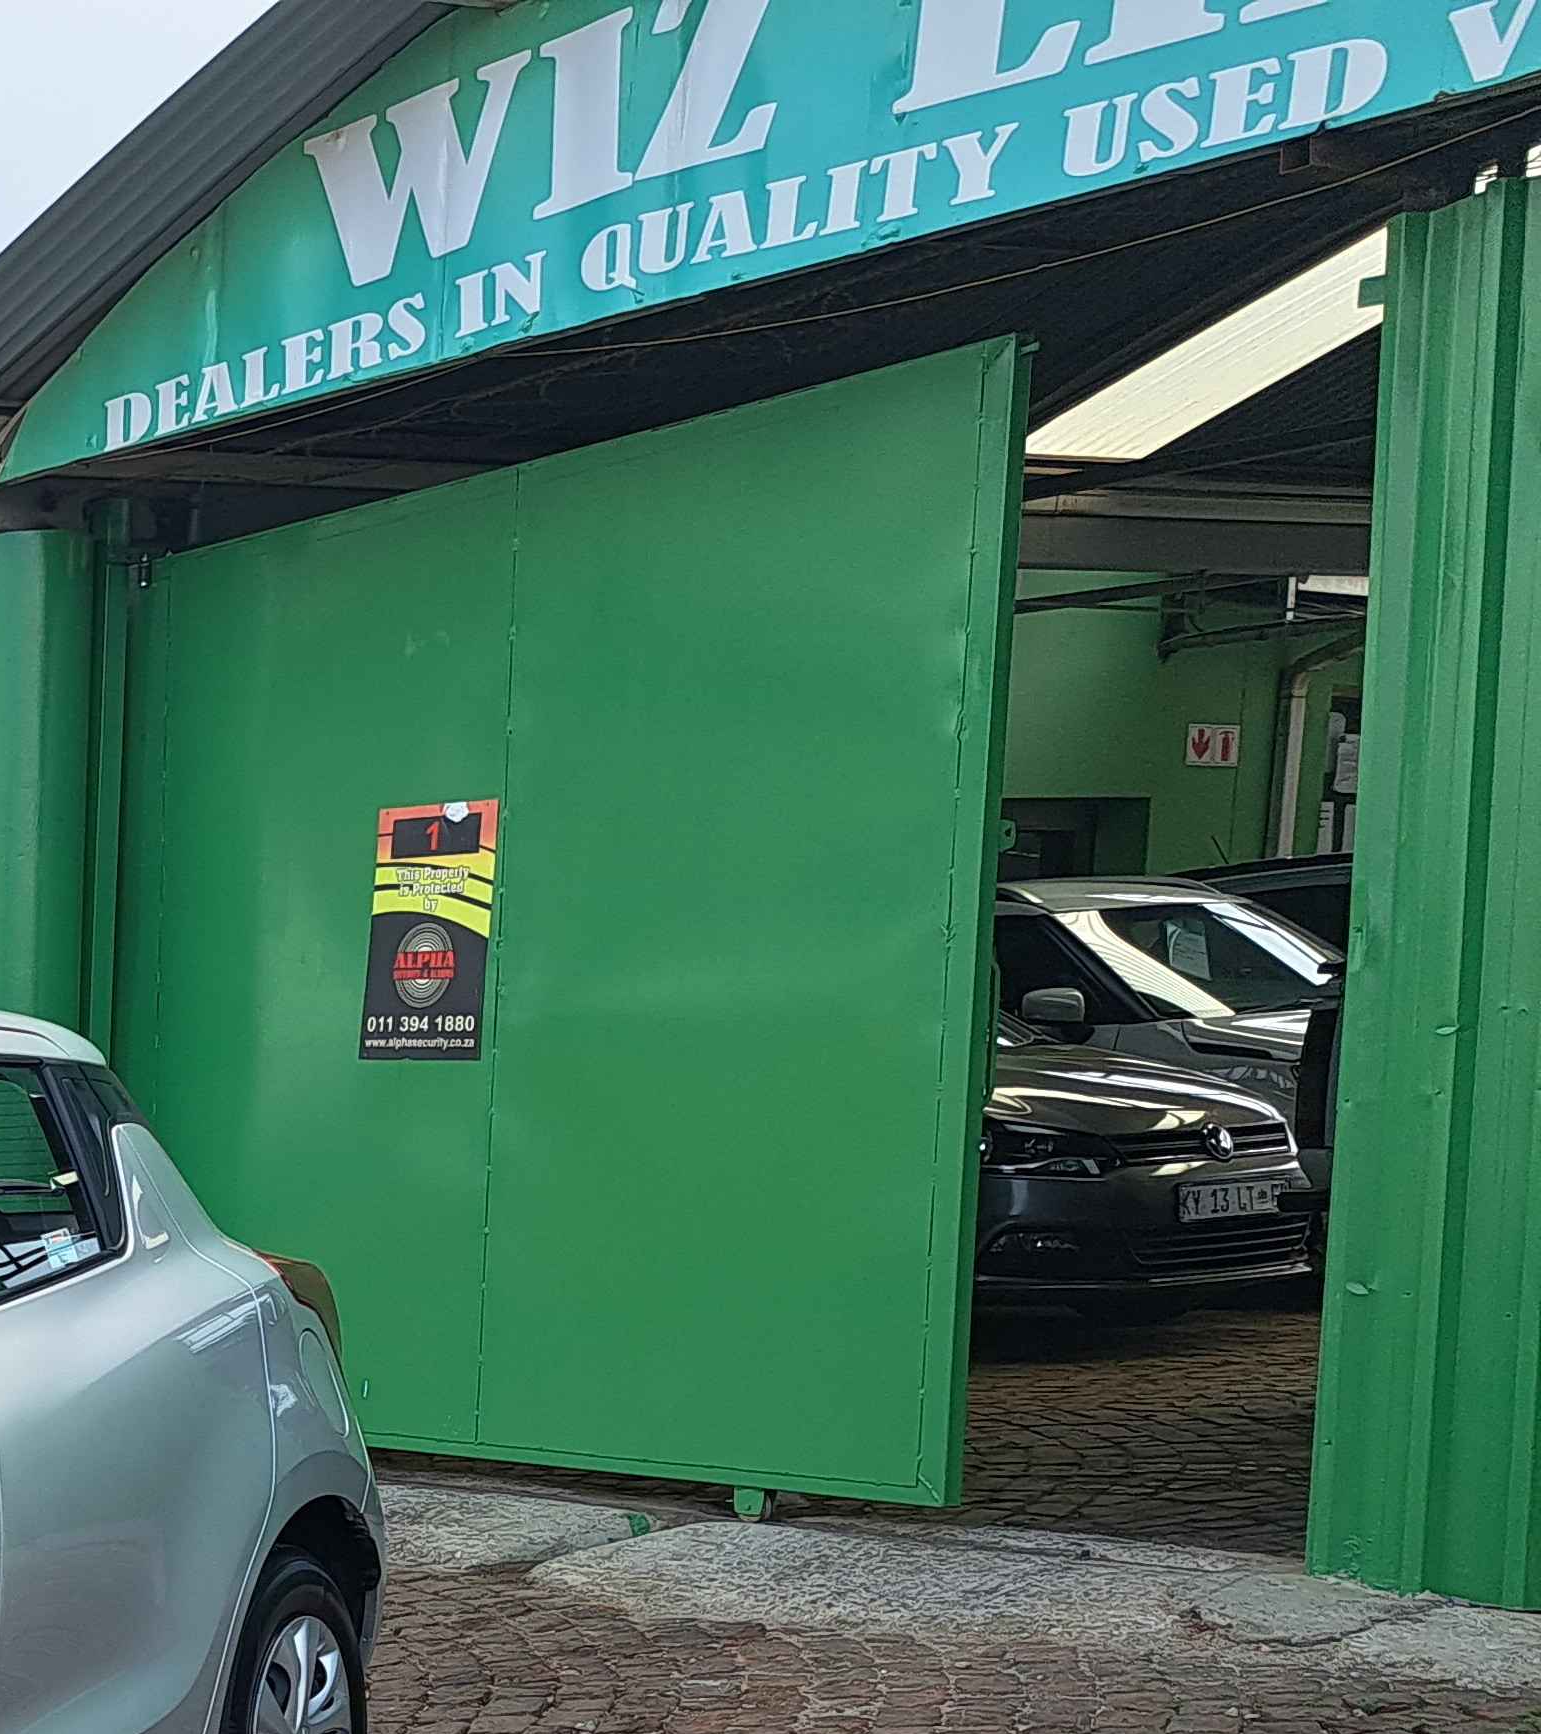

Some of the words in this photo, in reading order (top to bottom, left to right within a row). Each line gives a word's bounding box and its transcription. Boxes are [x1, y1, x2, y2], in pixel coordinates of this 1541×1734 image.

[303, 0, 777, 287] WIZ
[104, 292, 427, 453] DEALERS
[454, 250, 547, 339] IN
[580, 121, 1019, 293] QUALITY
[1063, 38, 1389, 177] USED
[397, 868, 420, 881] This
[423, 866, 470, 883] Property
[399, 883, 409, 896] is
[411, 881, 465, 895] Protected
[423, 898, 438, 912] by
[394, 950, 454, 969] ALPHA
[367, 1015, 394, 1033] 011
[399, 1015, 429, 1032] 394
[434, 1014, 475, 1032] 1880
[364, 1036, 475, 1051] www.alphasecurity.co.za
[1210, 1187, 1230, 1214] 13
[1236, 1185, 1255, 1212] LT
